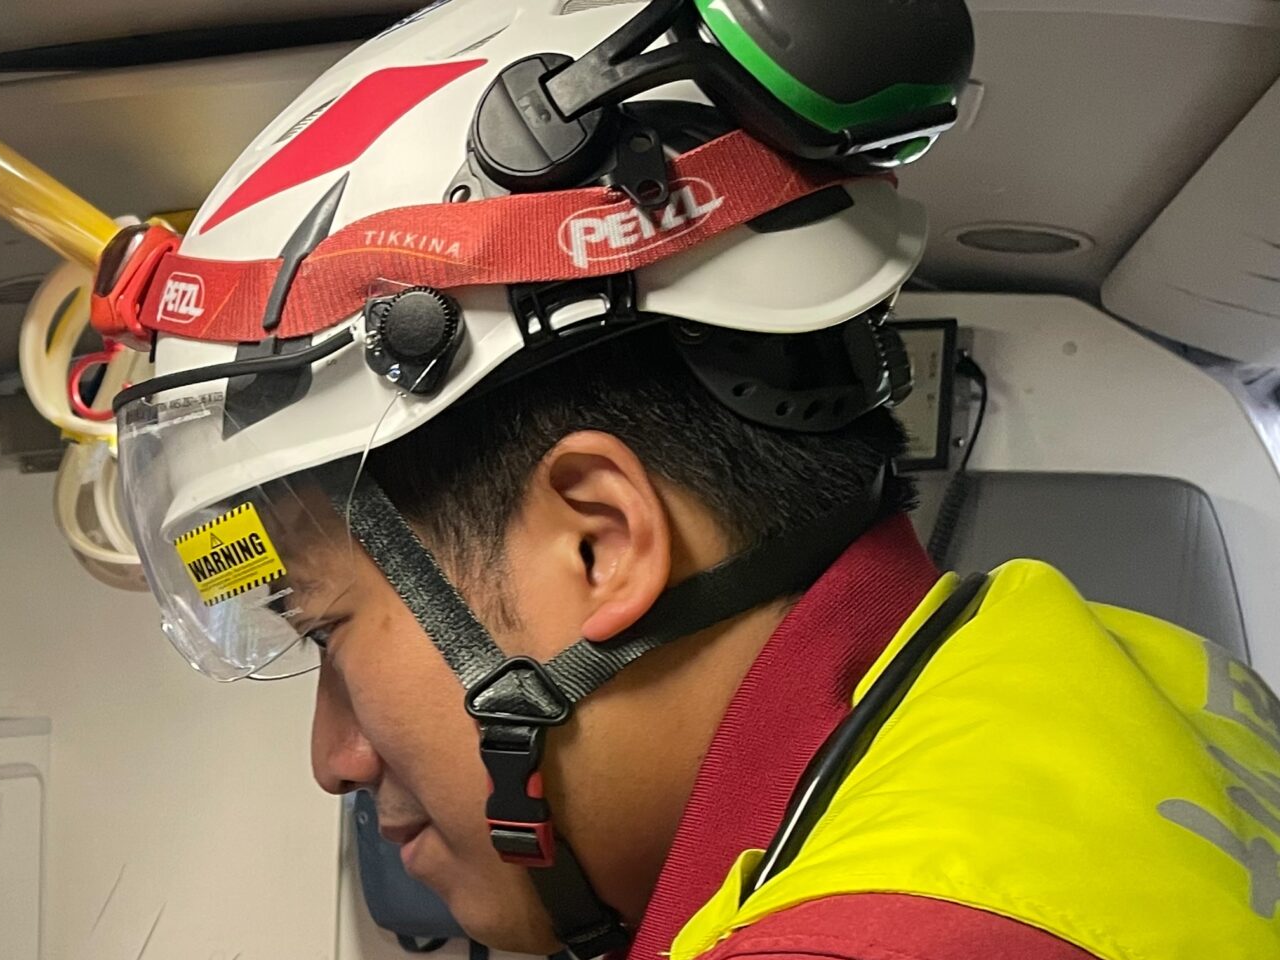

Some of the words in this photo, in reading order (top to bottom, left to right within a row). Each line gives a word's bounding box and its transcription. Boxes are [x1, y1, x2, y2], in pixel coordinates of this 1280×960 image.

[364, 230, 461, 258] TIKKINA
[570, 185, 725, 269] PETZL
[157, 279, 205, 322] PETZL
[188, 532, 267, 583] WARNING
